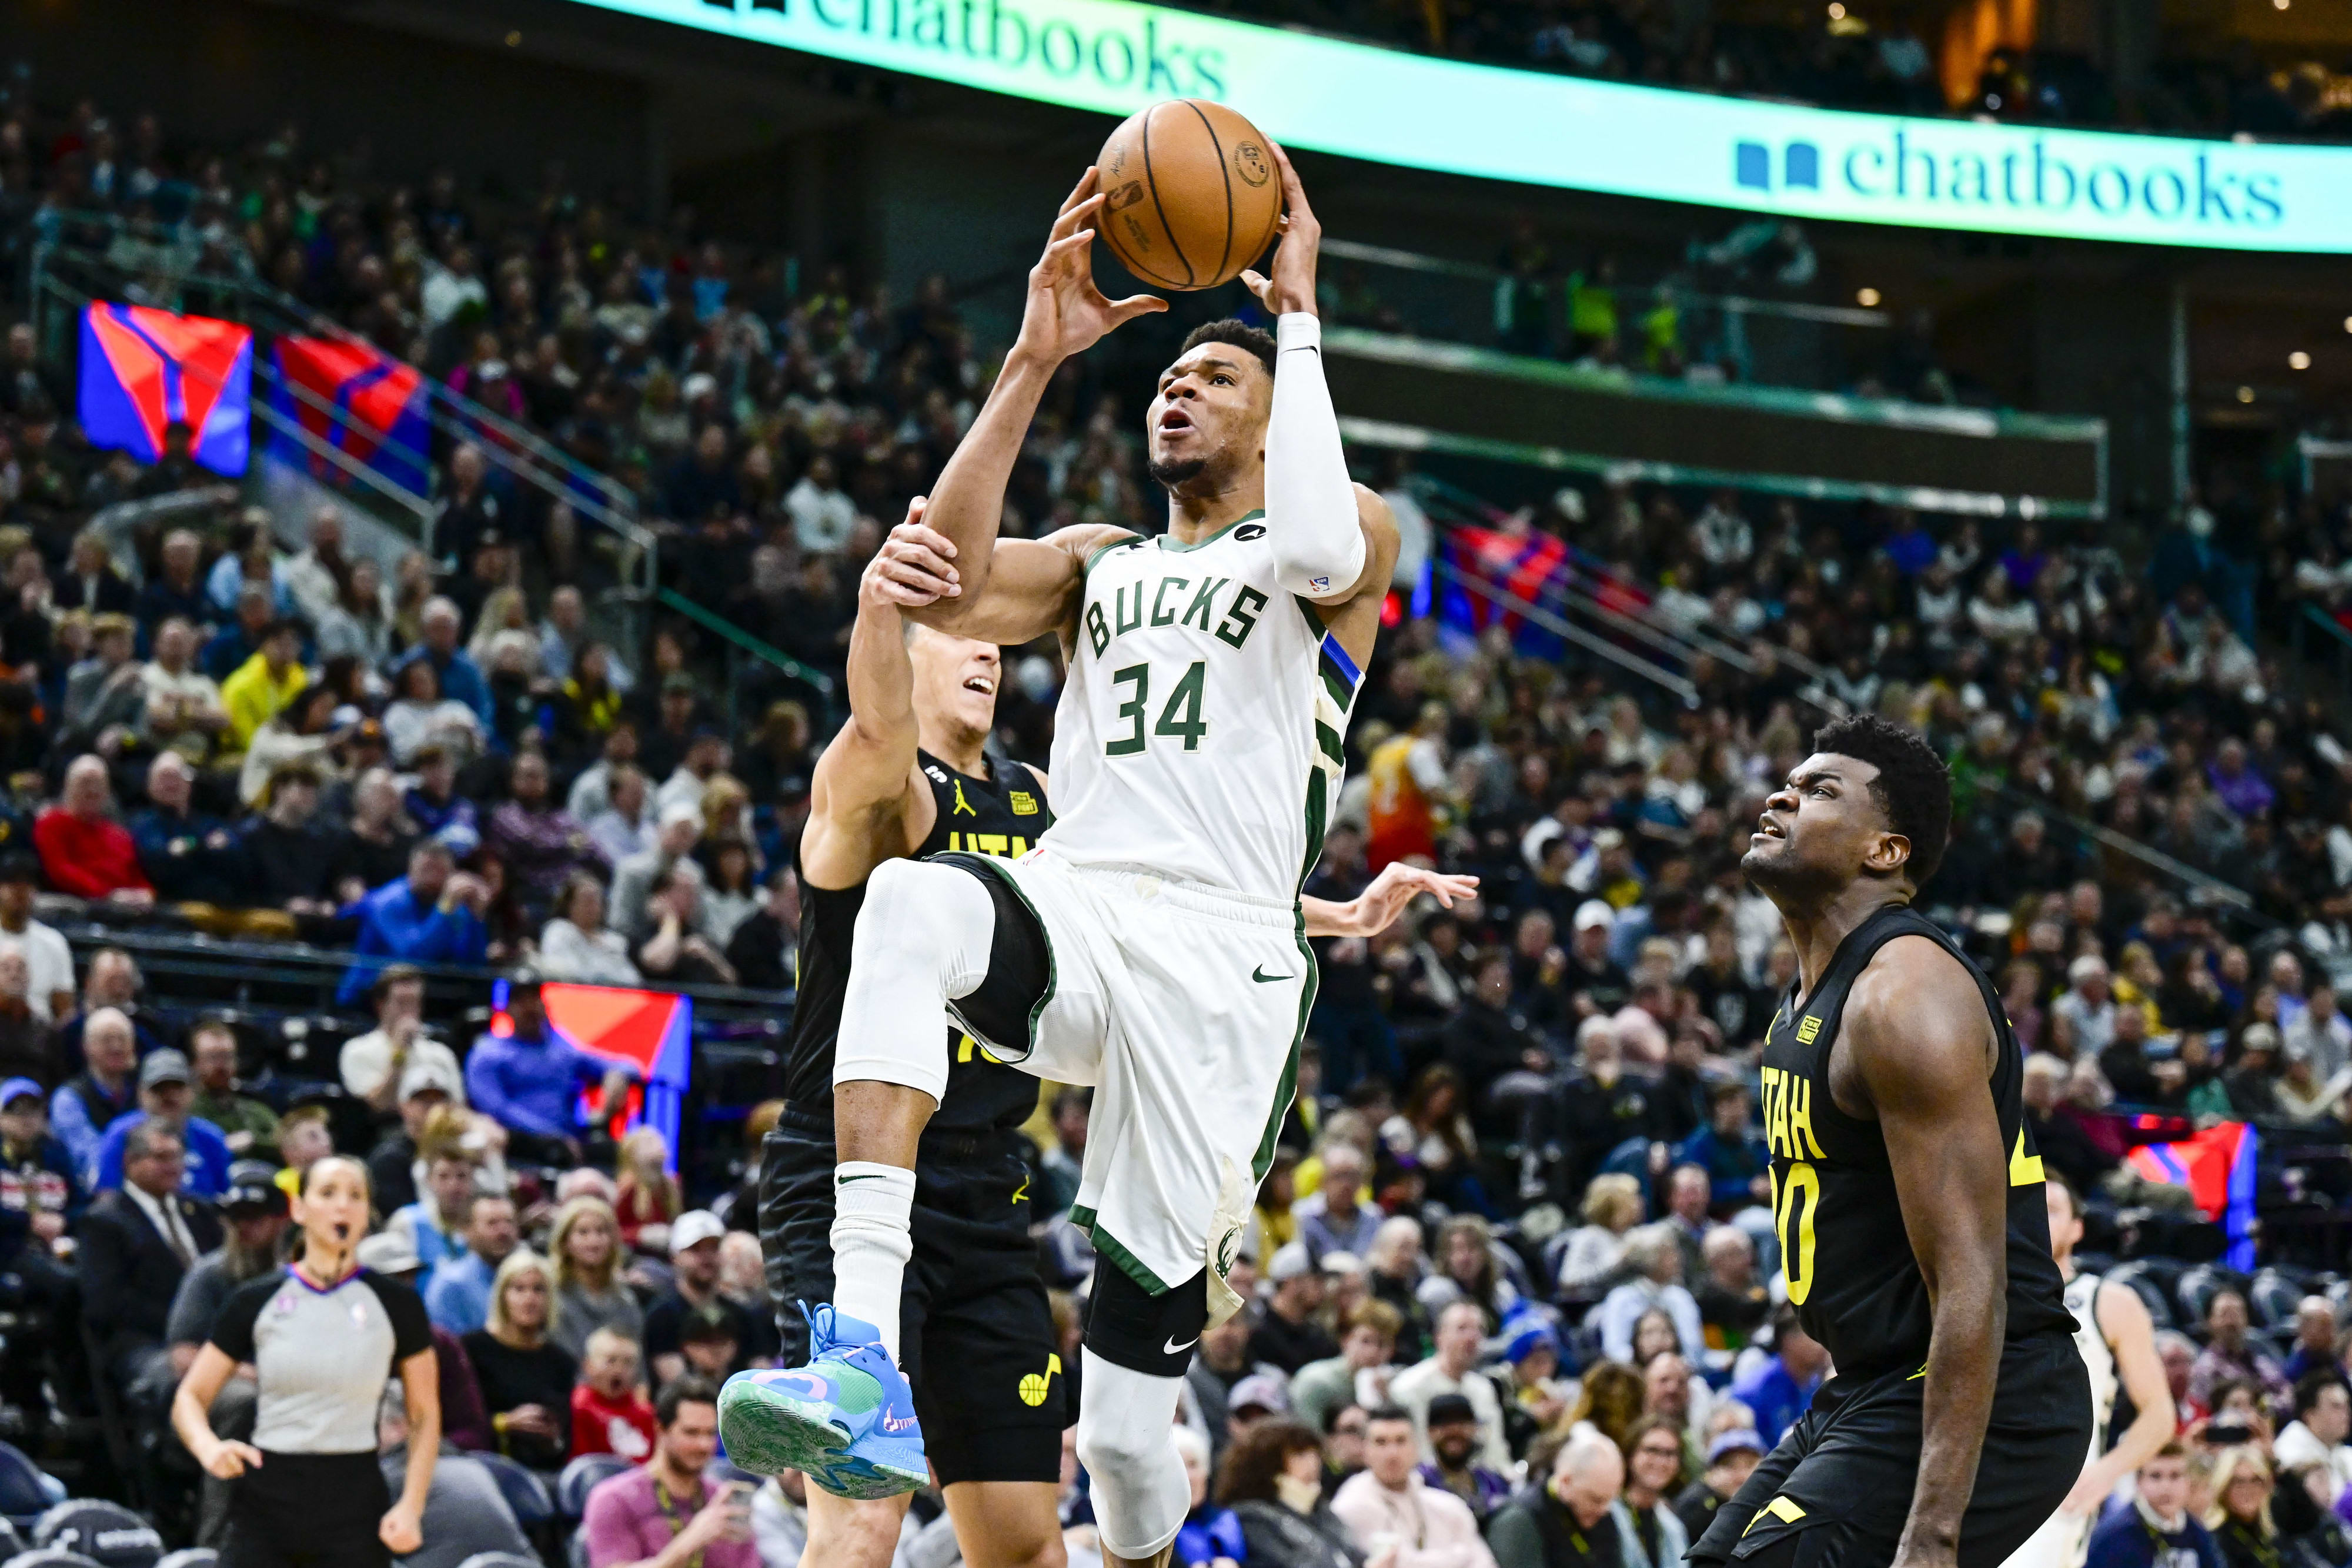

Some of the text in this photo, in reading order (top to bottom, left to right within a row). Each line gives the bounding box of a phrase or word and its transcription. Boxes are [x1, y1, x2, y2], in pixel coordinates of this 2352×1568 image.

[1845, 129, 2284, 226] chatbooks
[1085, 576, 1271, 661] BUCKS
[1105, 660, 1208, 757] 34
[1768, 1162, 1819, 1305] 0
